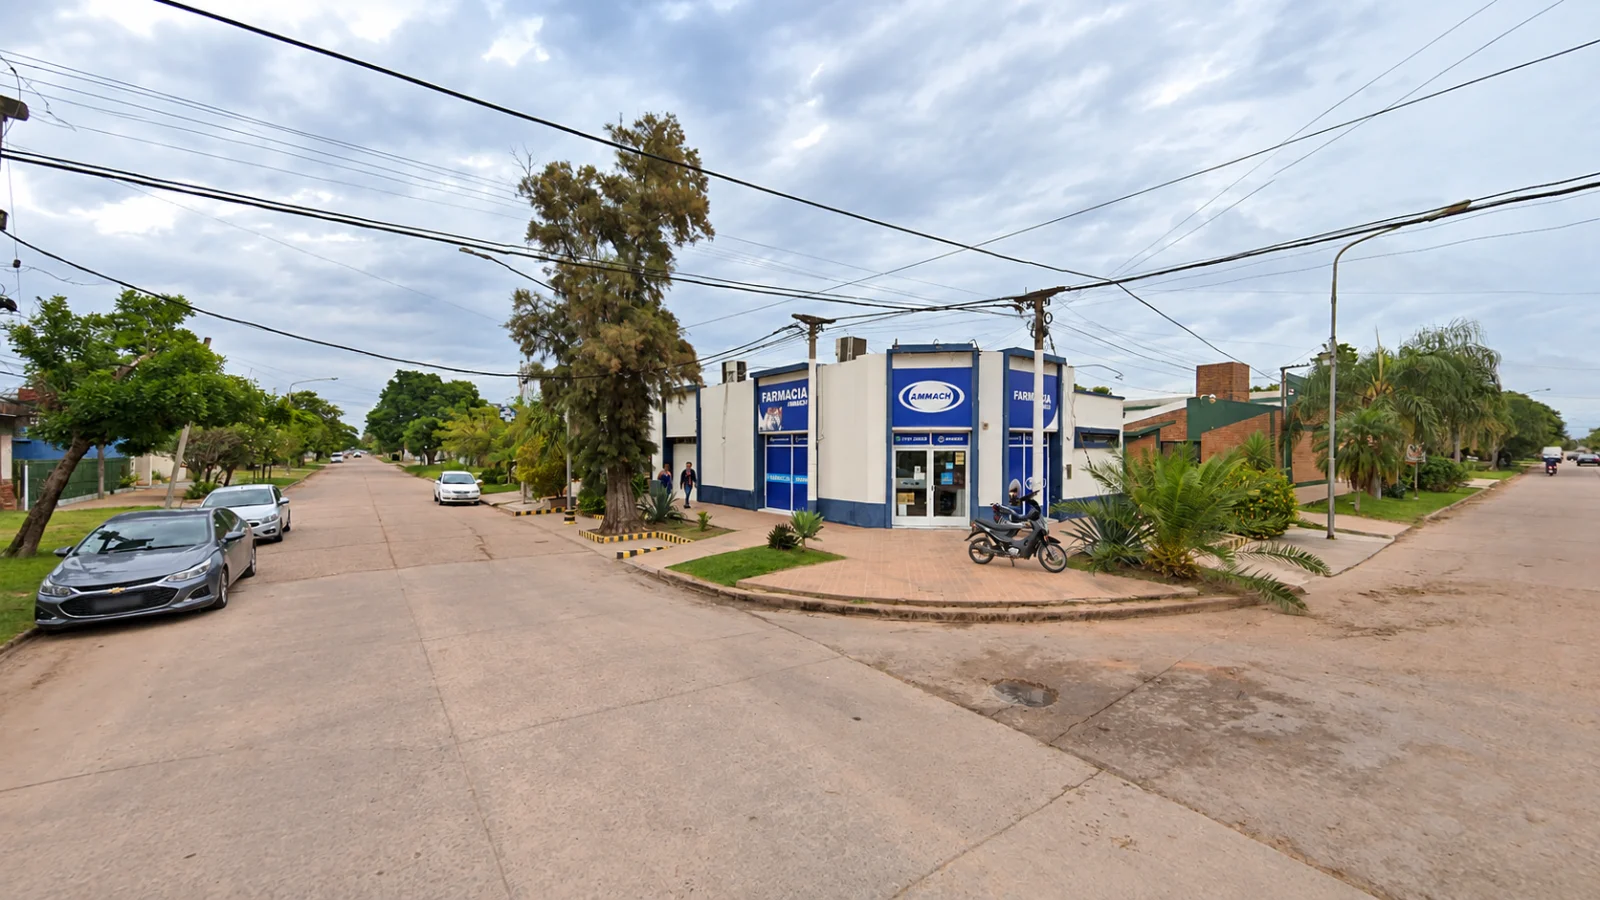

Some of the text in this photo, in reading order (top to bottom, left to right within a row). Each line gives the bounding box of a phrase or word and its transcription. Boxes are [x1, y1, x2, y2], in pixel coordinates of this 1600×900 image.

[762, 387, 807, 403] FARMACIA
[910, 392, 951, 400] AMMACH
[1013, 390, 1051, 404] FARMIA
